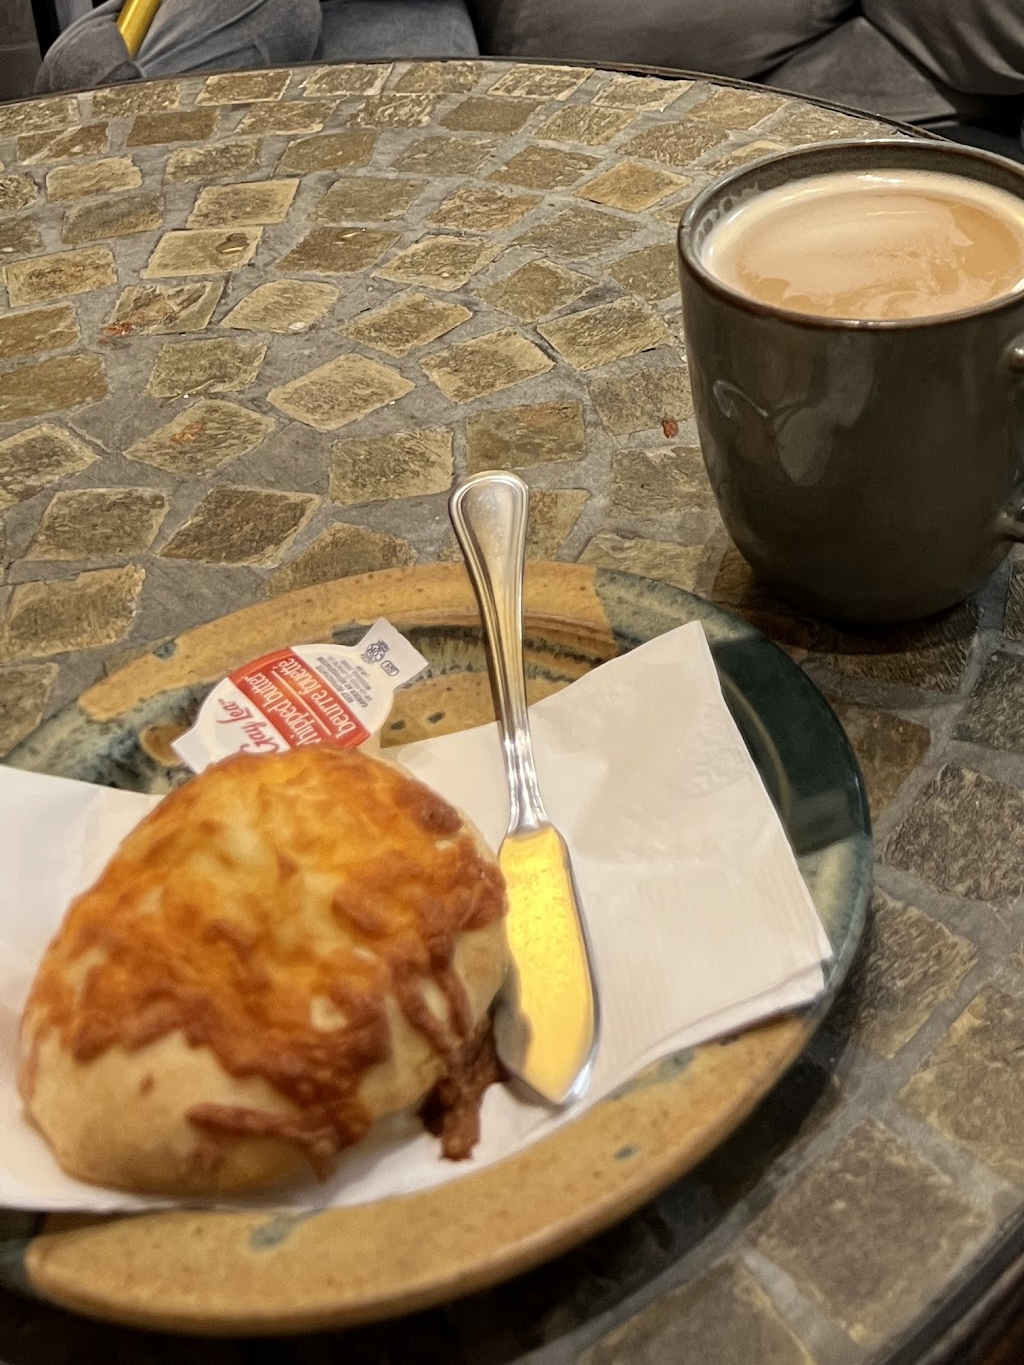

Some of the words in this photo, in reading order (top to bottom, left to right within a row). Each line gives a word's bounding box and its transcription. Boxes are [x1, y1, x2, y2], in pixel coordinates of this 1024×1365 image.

[244, 670, 284, 707] butter
[272, 655, 322, 693] fouetté
[309, 687, 357, 738] beurre
